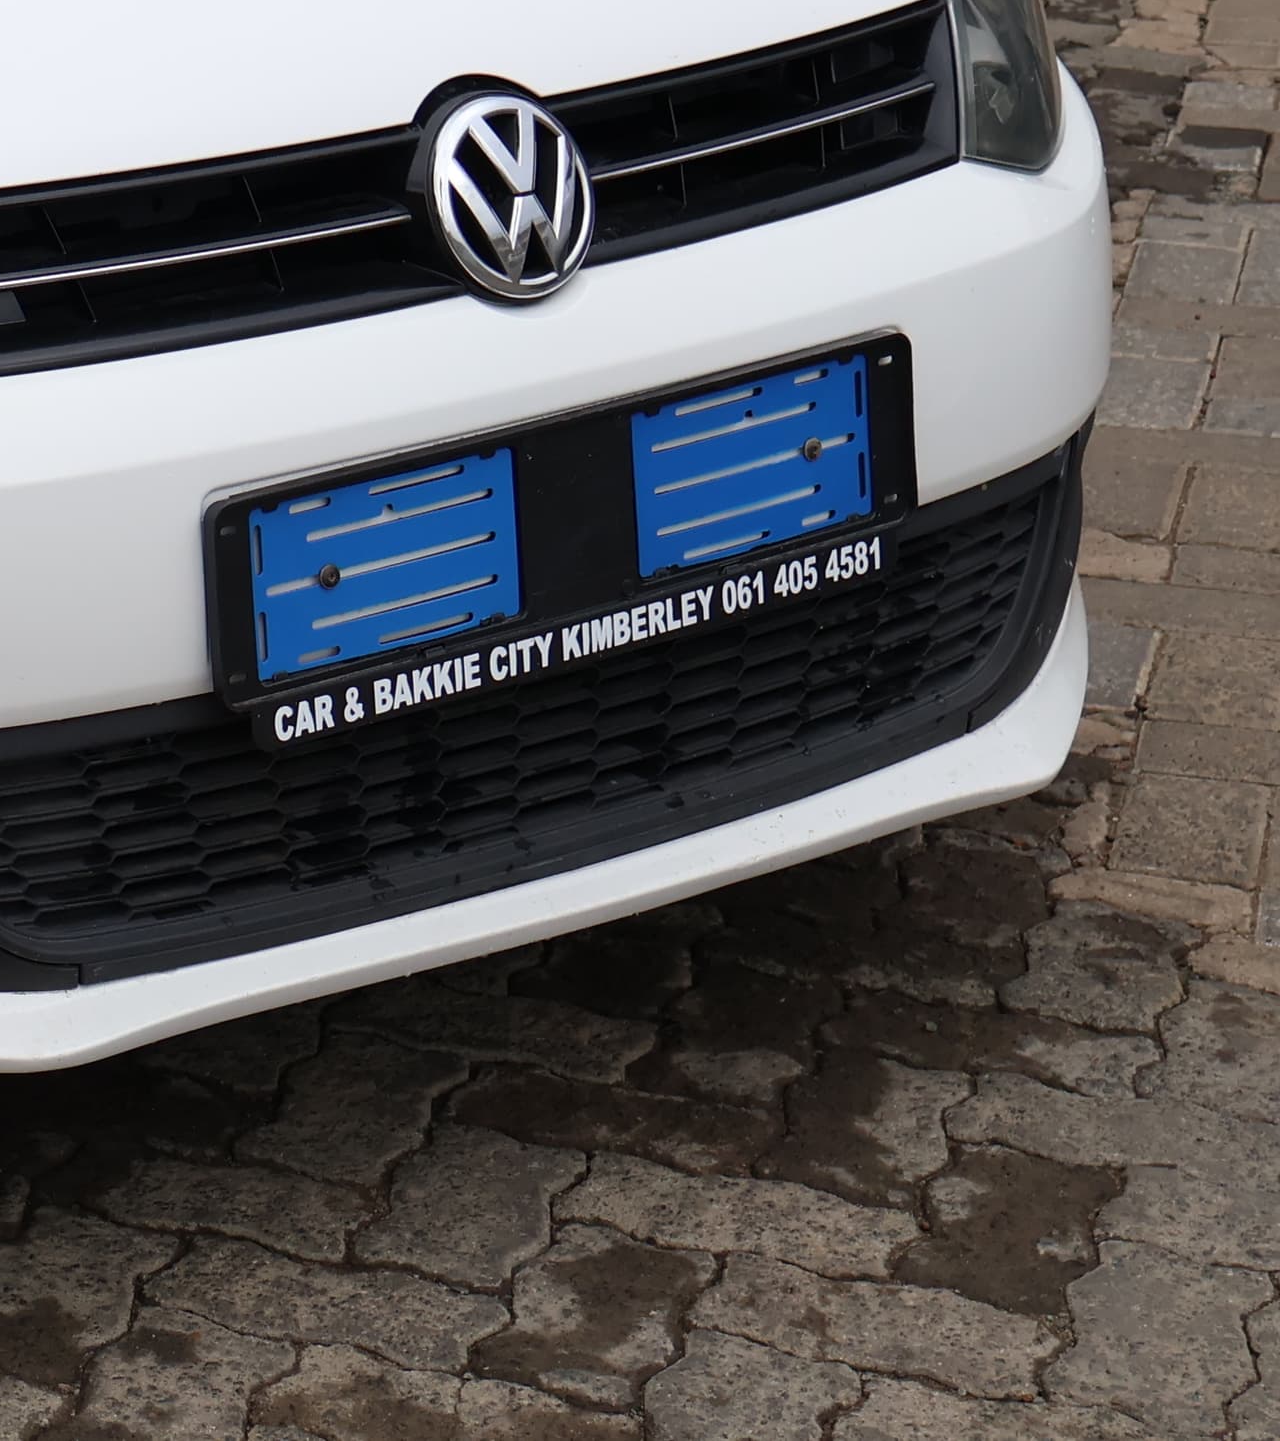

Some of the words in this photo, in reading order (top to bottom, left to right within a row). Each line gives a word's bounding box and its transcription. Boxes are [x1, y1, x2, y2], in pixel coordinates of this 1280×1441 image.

[436, 99, 590, 296] VW
[274, 694, 336, 742] CAR
[343, 686, 365, 724] &
[373, 653, 482, 715] BAKKIE
[489, 632, 554, 682] CITY
[561, 585, 714, 661] KIMBERLEY
[721, 570, 765, 615] 061
[773, 556, 819, 598] 405
[824, 536, 882, 583] 4581
